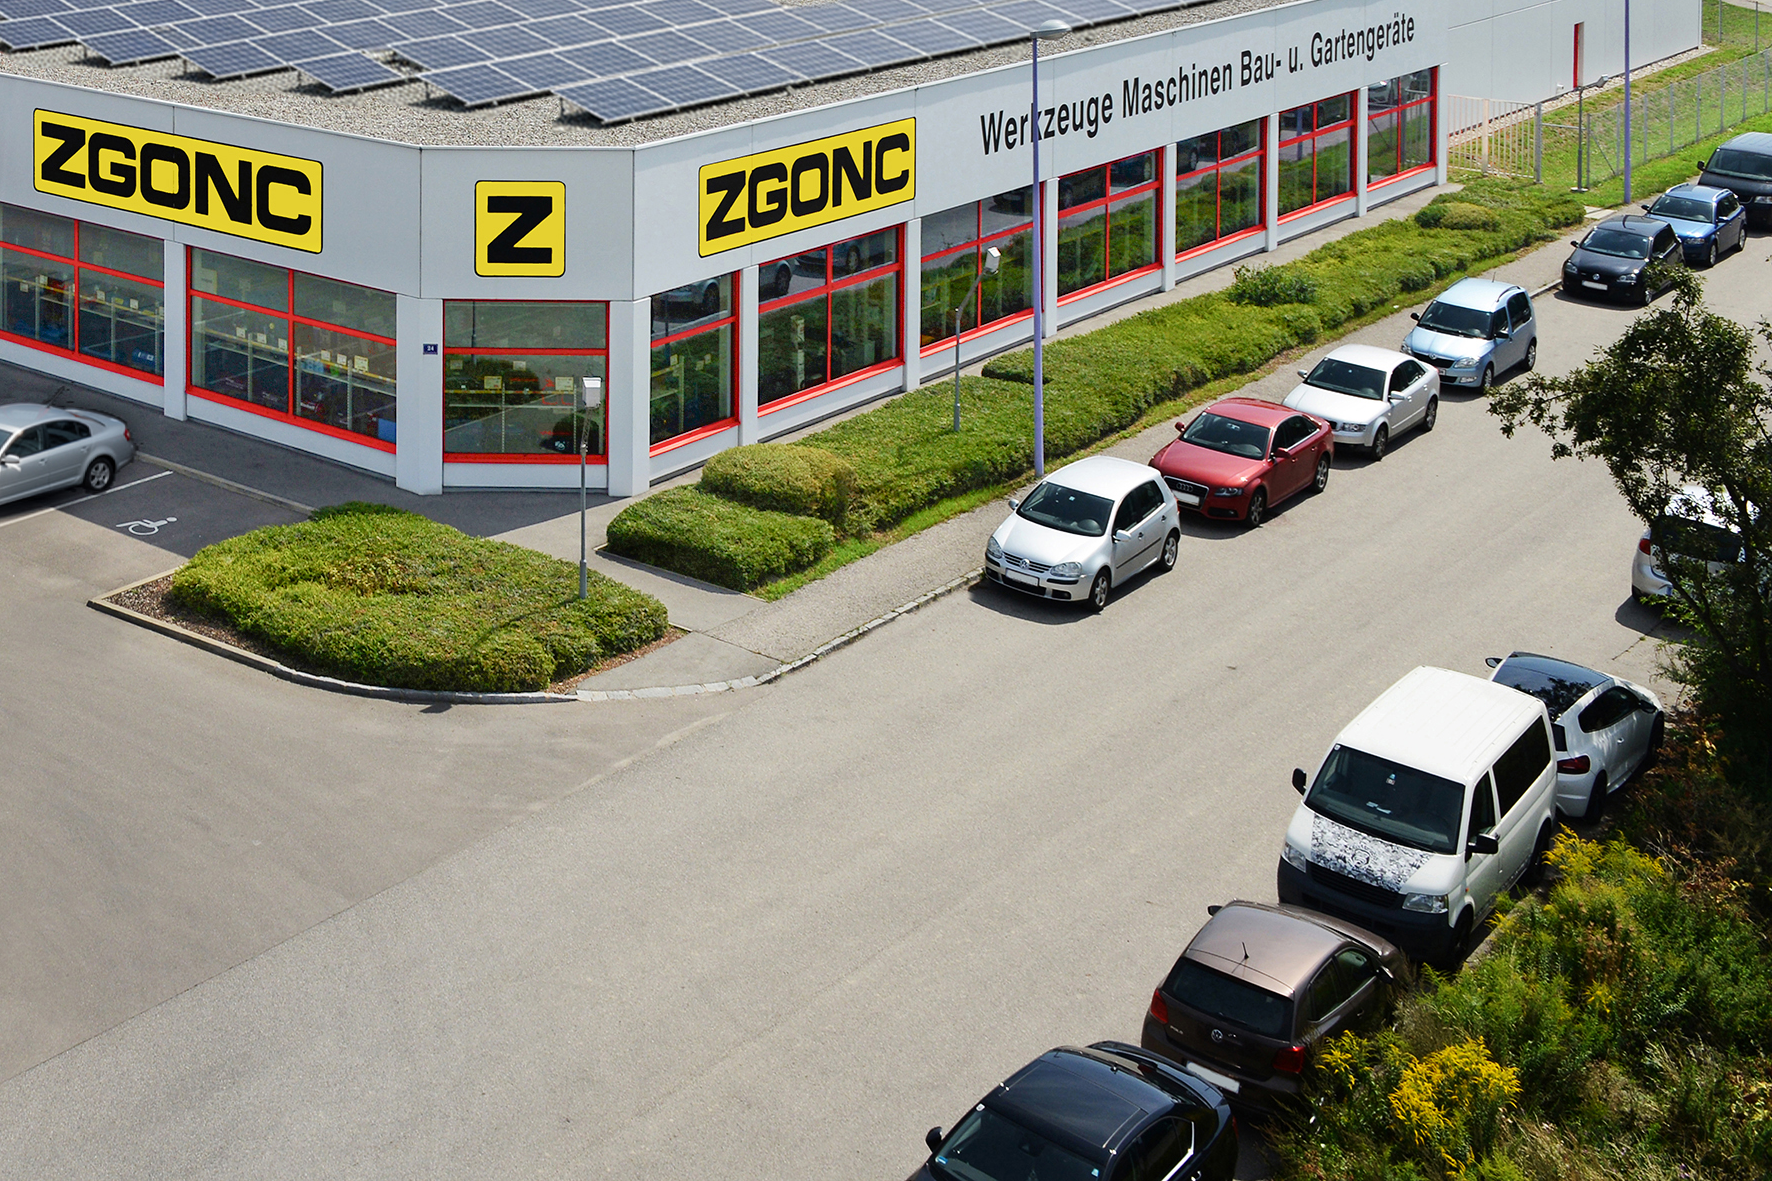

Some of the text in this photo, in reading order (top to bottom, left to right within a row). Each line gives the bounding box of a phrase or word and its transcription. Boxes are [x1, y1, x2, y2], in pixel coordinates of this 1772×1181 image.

[980, 11, 1415, 156] Werkzeuge Maschinen Bau- u. Gartengeräte
[40, 121, 313, 237] ZGONC
[486, 195, 553, 265] Z
[706, 132, 910, 241] ZGONC
